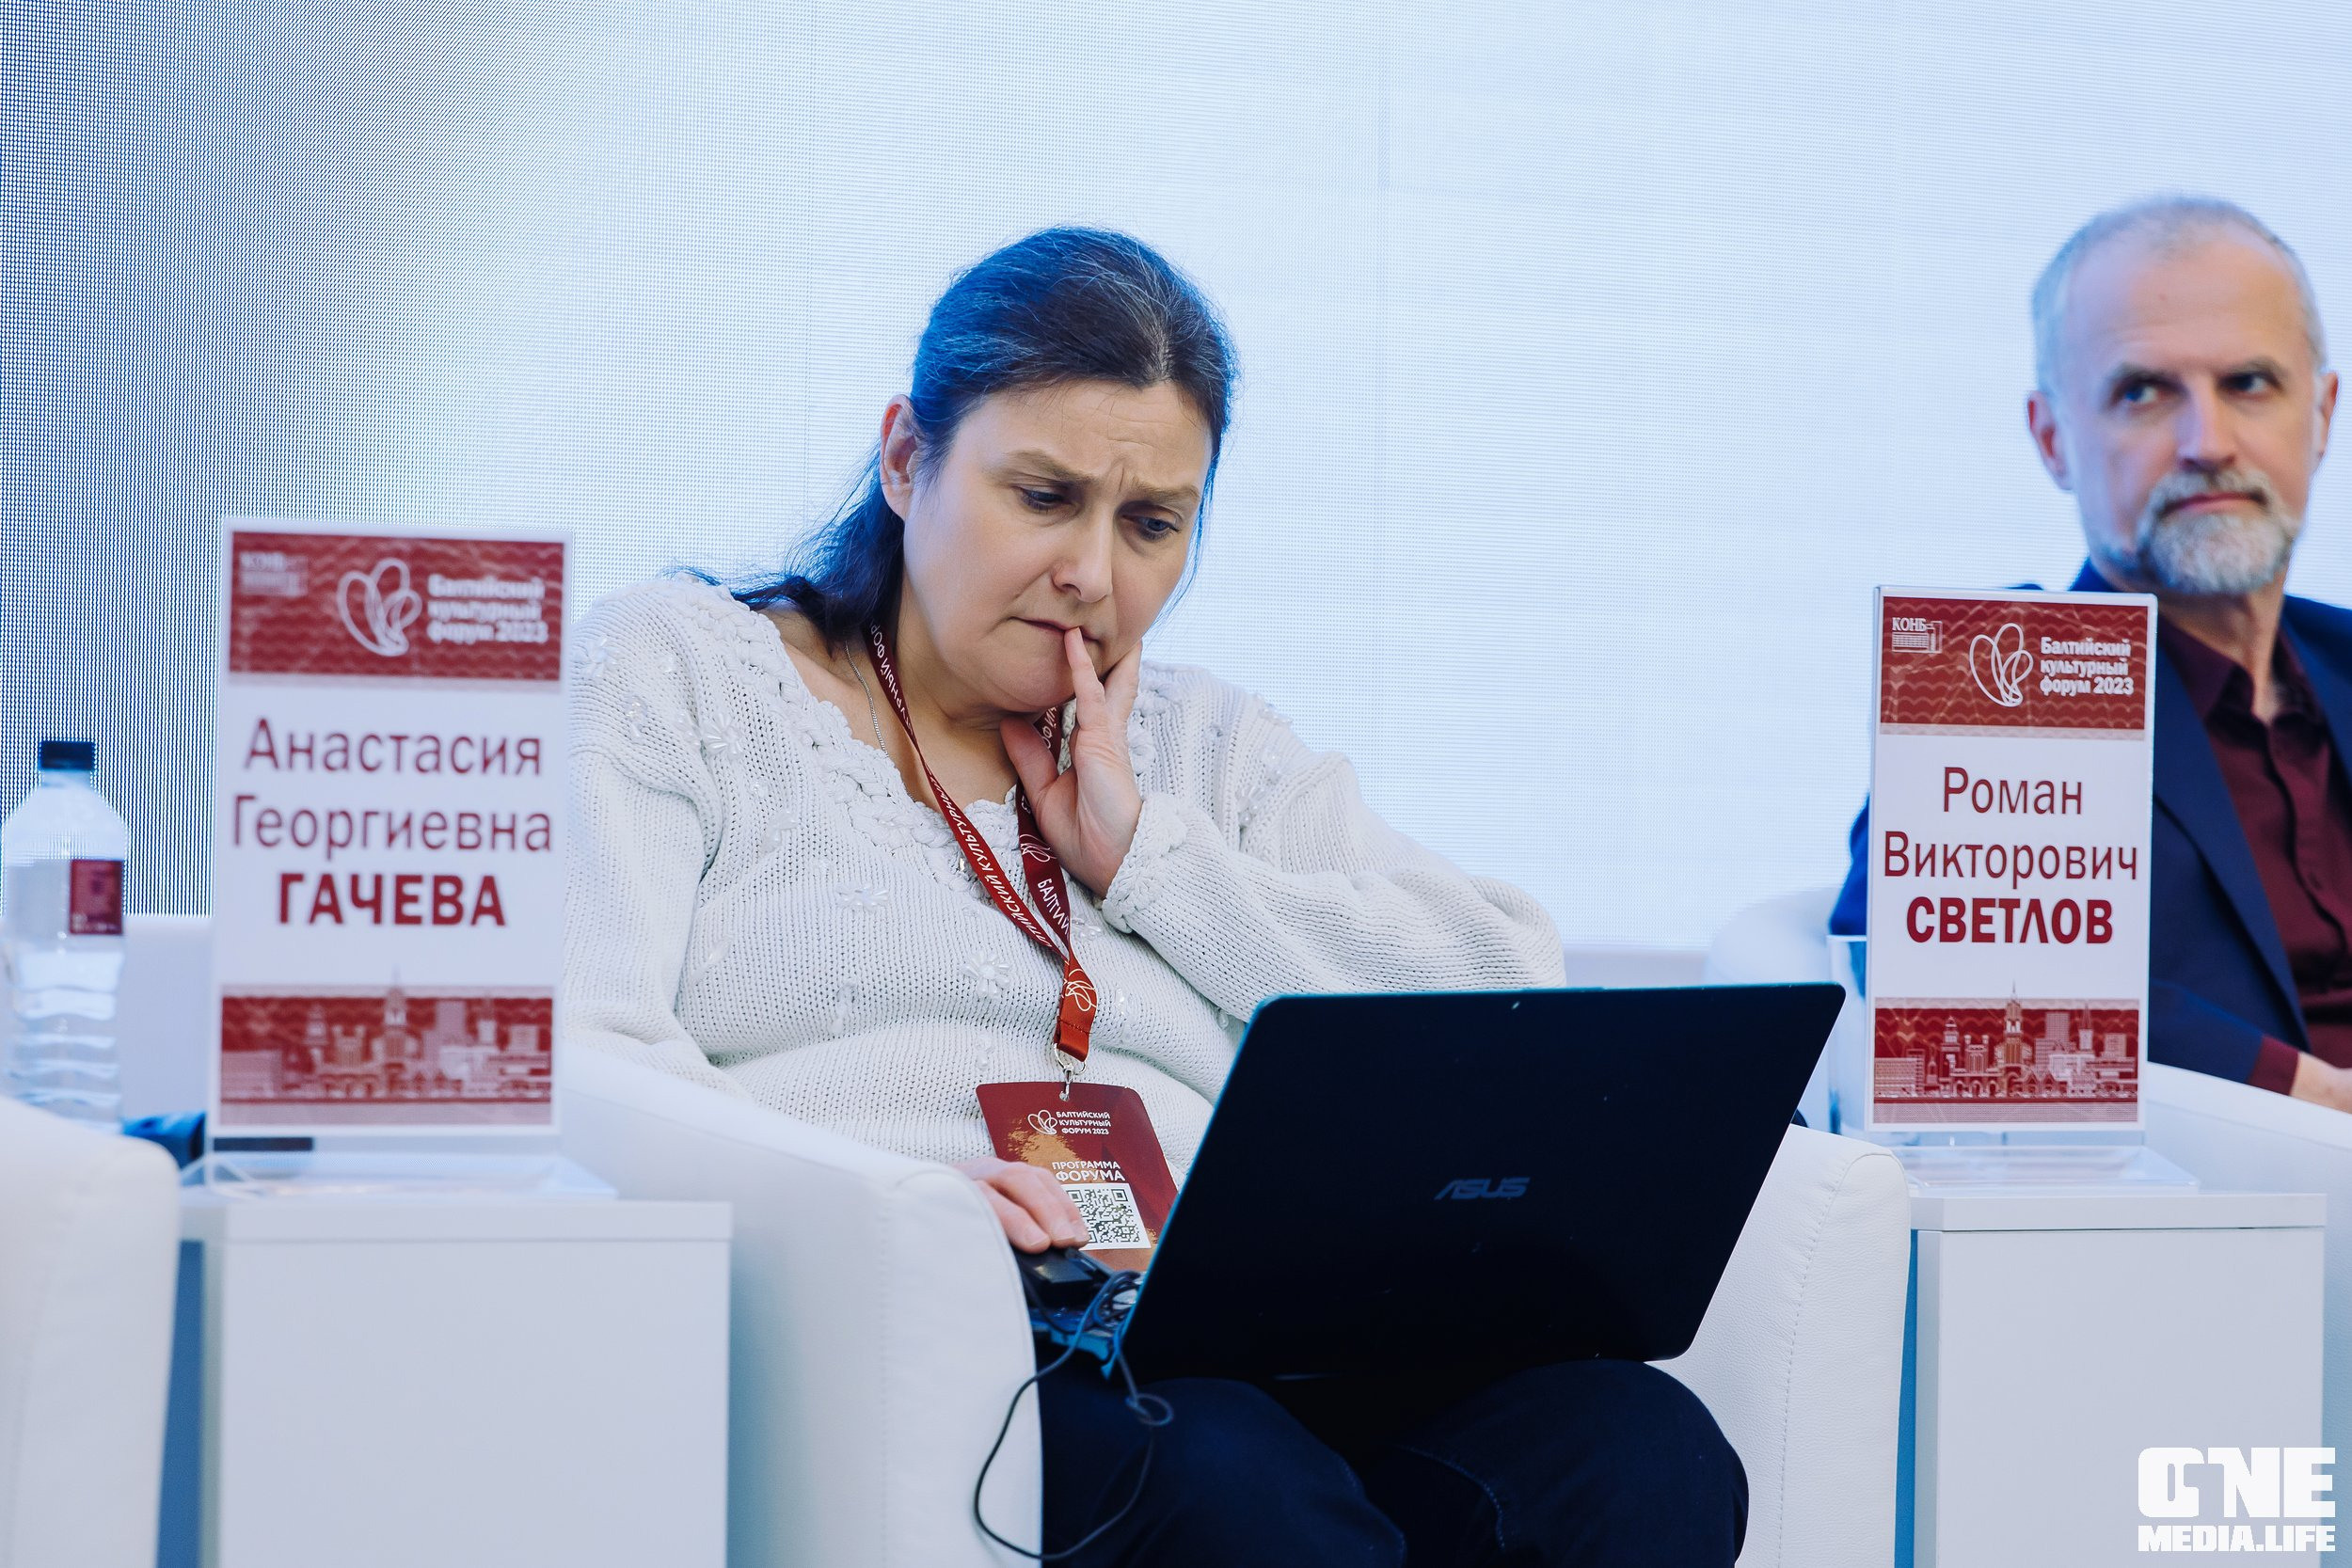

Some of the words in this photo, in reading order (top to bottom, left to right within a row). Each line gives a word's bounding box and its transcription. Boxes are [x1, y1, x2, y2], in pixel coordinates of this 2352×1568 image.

[1892, 616, 1928, 632] КОНБ
[2040, 636, 2132, 657] Балтийский
[2040, 657, 2129, 678] культурный
[2039, 674, 2091, 697] форум
[2093, 675, 2135, 695] 2023
[245, 717, 542, 776] Анастасия
[1943, 766, 2083, 816] Роман
[233, 794, 552, 862] Георгиевна
[1883, 831, 2137, 890] Викторович
[278, 872, 506, 927] ГАЧЕВА
[1905, 896, 2114, 944] СВЕТЛОВ
[1056, 1111, 1111, 1119] БАЛТИЙСКИЙ
[1058, 1119, 1112, 1128] КУЛЬТУРНЫЙ
[1051, 1160, 1121, 1170] ПРОГРАММА
[1055, 1169, 1126, 1182] ФОРУМА
[1434, 1177, 1531, 1200] ASUS
